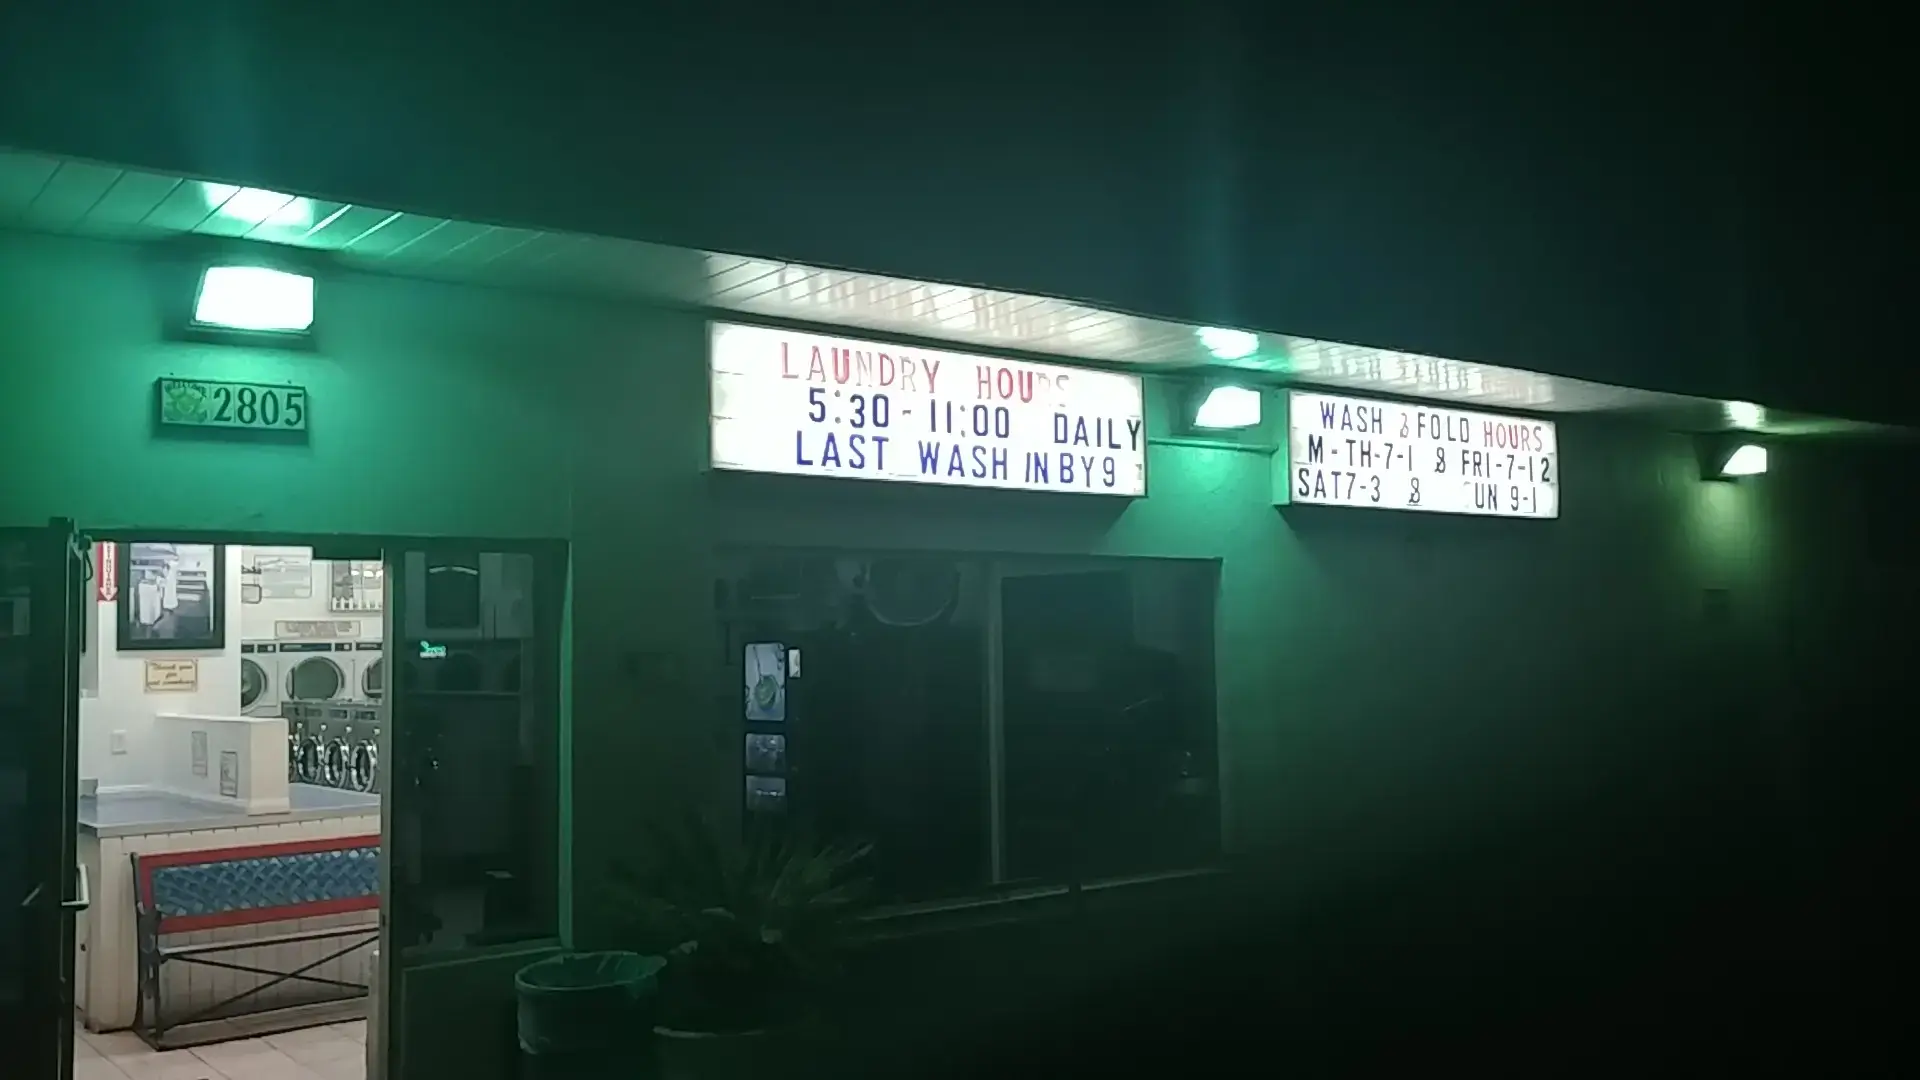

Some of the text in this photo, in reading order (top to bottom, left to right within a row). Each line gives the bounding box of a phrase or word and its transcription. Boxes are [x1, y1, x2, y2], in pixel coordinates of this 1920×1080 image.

[781, 341, 941, 394] LAUNDRY
[213, 387, 303, 426] 2805
[808, 386, 889, 429] 5:30
[930, 398, 1010, 439] 11:00
[1053, 411, 1141, 452] DAILY
[1319, 400, 1383, 434] WASH
[1417, 412, 1470, 443] FOLD
[1483, 420, 1543, 453] HOURS
[796, 429, 889, 471] LAST
[918, 439, 1008, 480] WASH
[1025, 451, 1049, 485] IN
[1463, 480, 1498, 512] UN
